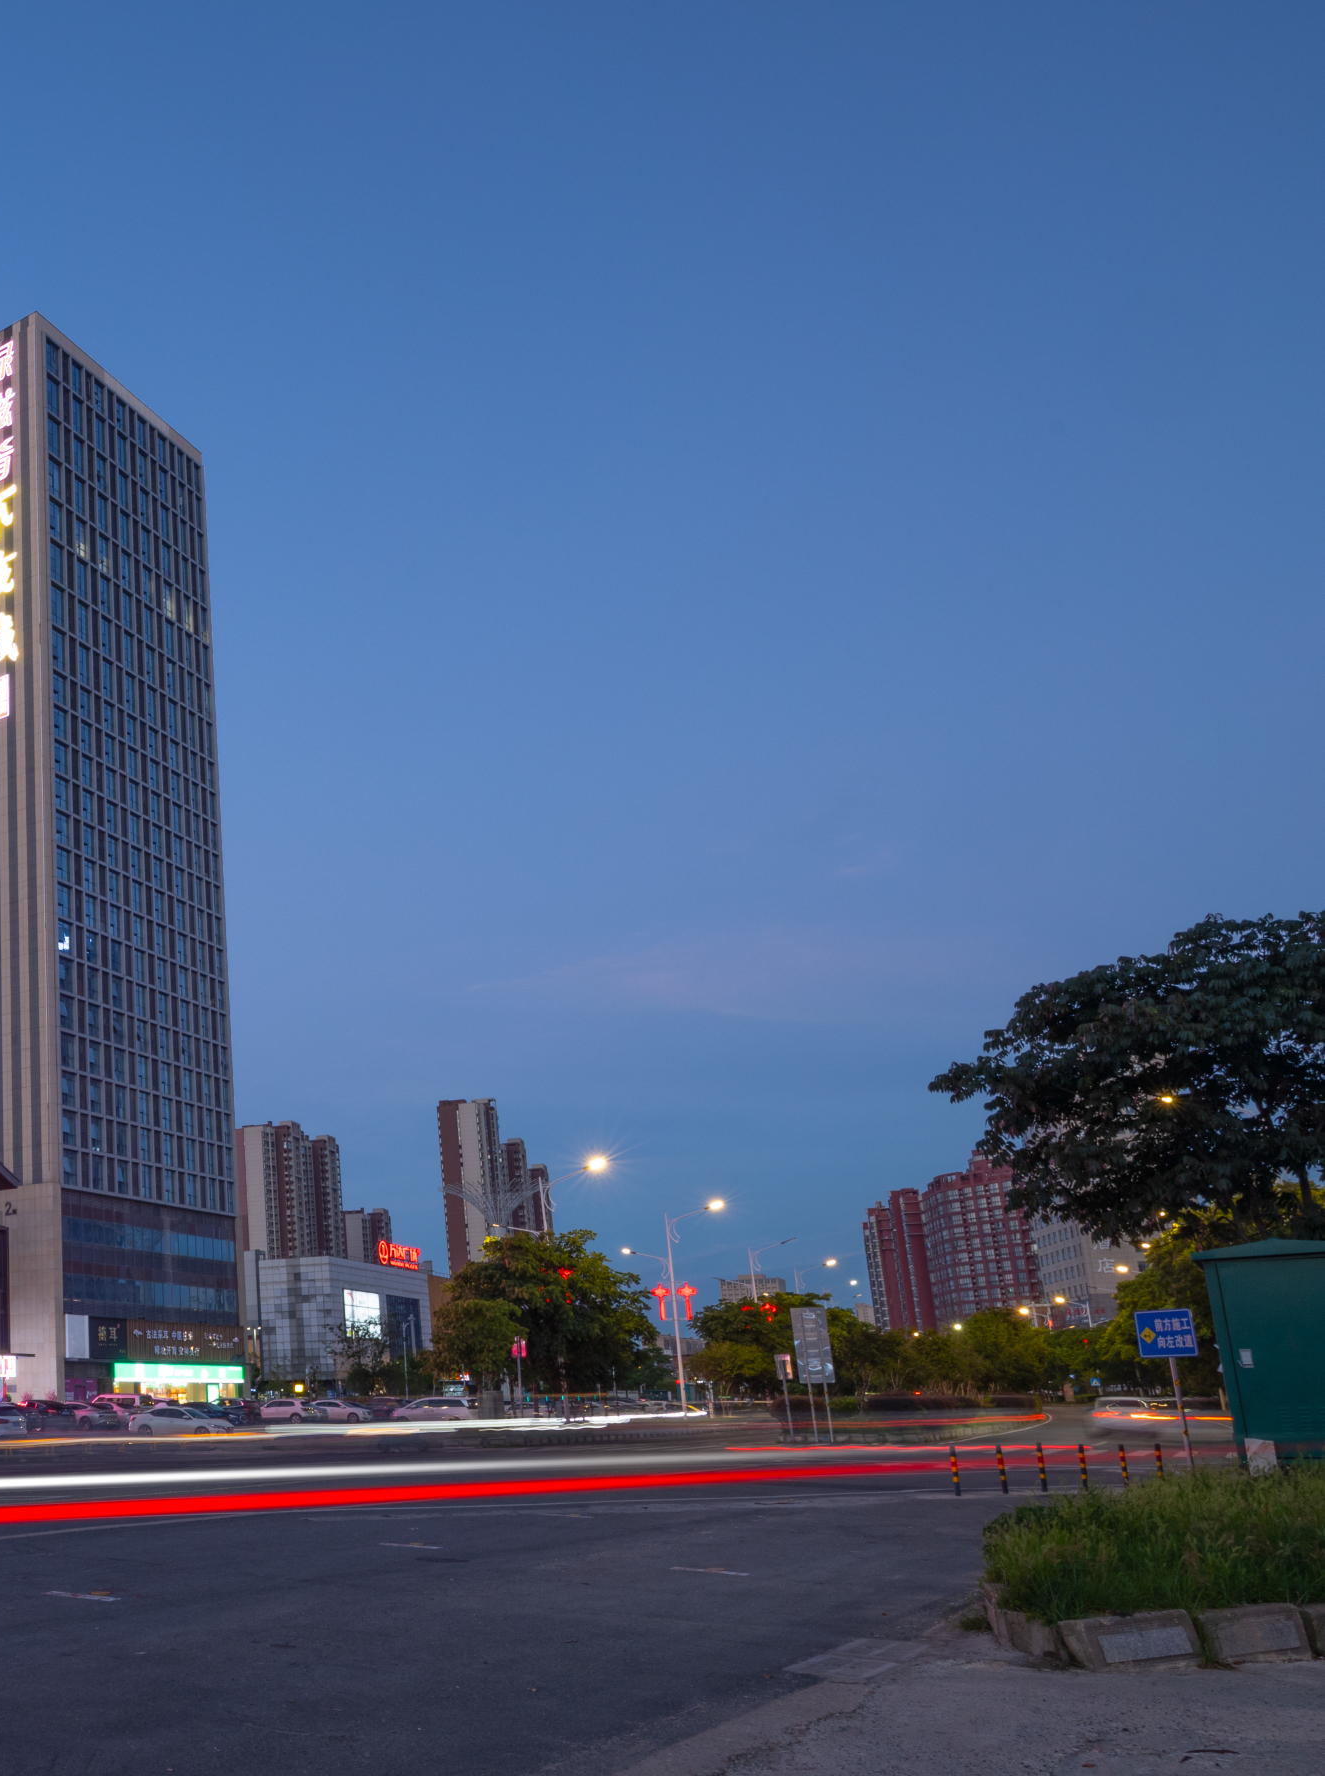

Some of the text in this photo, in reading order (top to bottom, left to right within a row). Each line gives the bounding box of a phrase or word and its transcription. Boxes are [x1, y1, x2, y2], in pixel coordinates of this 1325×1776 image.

[388, 1243, 419, 1263] 万达广场
[1153, 1317, 1191, 1332] 前方施工
[146, 1329, 169, 1341] 古法采耳
[1157, 1333, 1194, 1349] 向左改道
